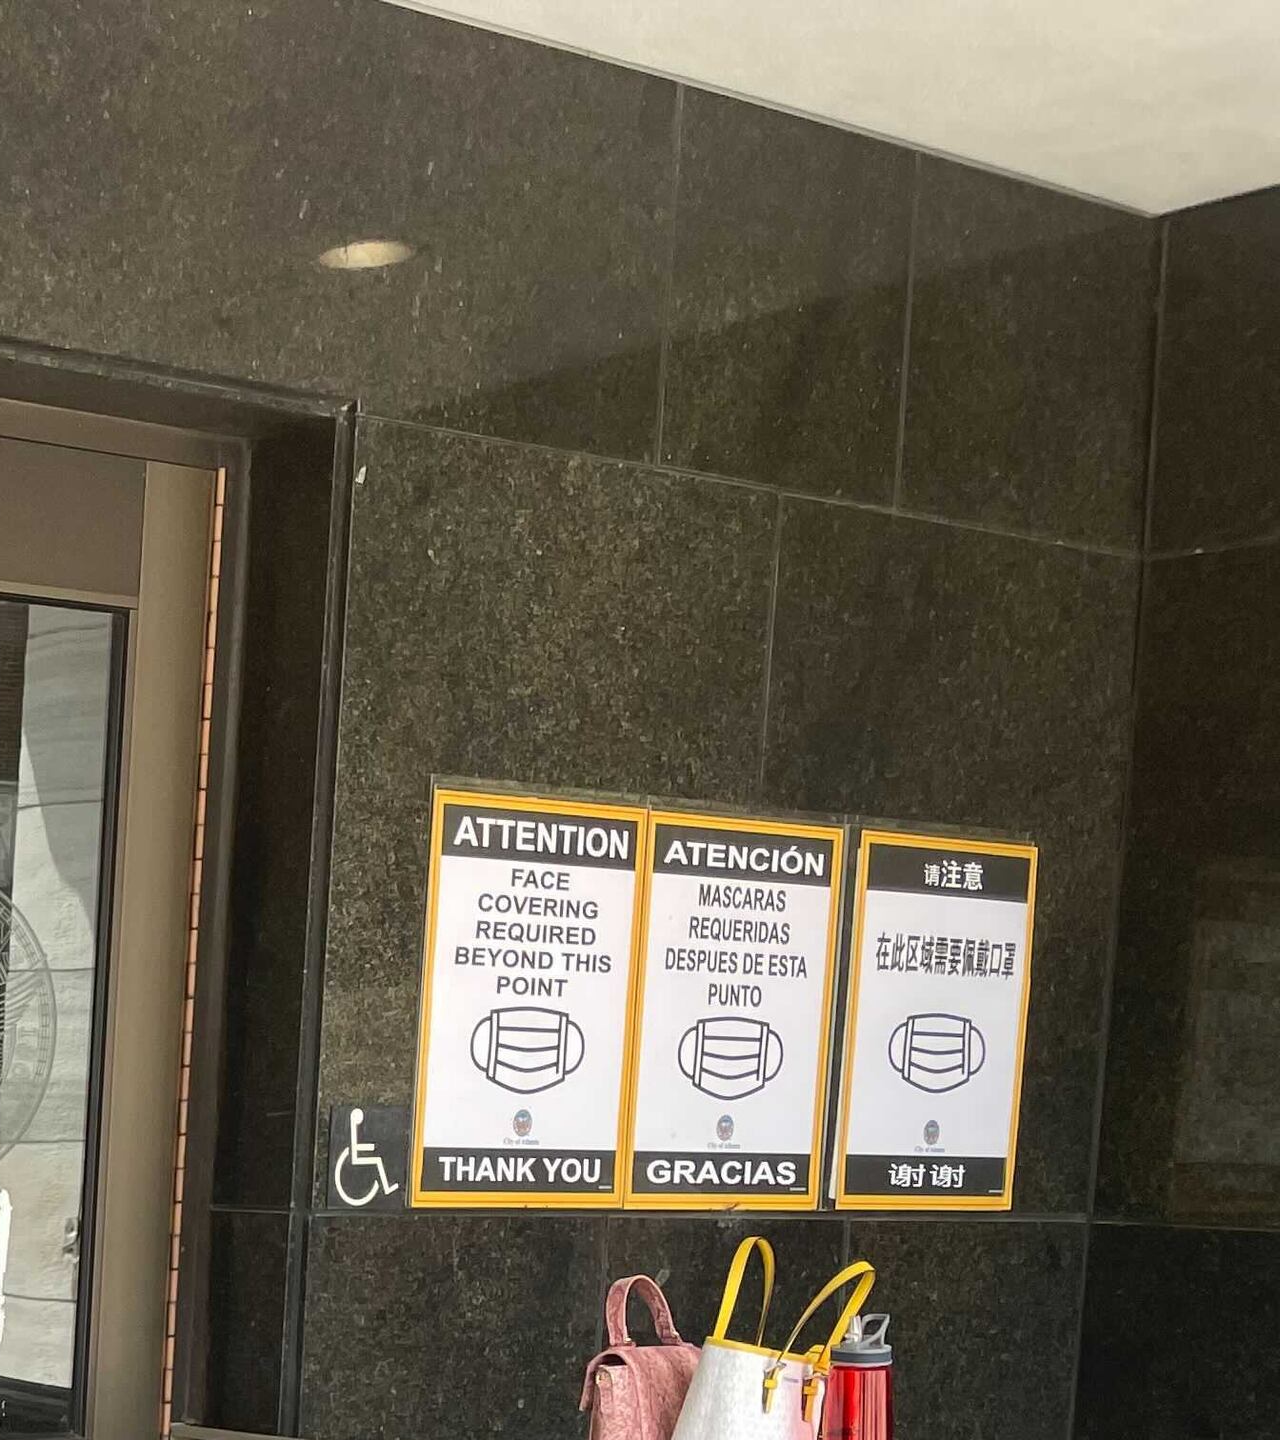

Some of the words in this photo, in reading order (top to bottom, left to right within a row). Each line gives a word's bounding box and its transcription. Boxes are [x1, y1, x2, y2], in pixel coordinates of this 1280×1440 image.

[453, 816, 629, 860] ATTENTION
[664, 841, 824, 876] ATENCIÓN
[511, 868, 570, 891] FACE
[924, 859, 983, 891] 请注意
[478, 893, 598, 919] COVERING
[698, 884, 787, 912] MASCARAS
[476, 920, 596, 945] REQUIRED
[689, 916, 790, 945] REQUERIDAS
[455, 946, 553, 969] BEYOND
[561, 953, 611, 973] THIS
[665, 948, 738, 974] DESPUES
[743, 953, 764, 975] DE
[768, 954, 807, 979] ESTA
[876, 930, 1016, 979] 在此区域需要佩戴口罩
[497, 976, 568, 997] POINT
[708, 984, 762, 1008] PUNTO
[438, 1156, 536, 1183] THANK
[542, 1157, 601, 1184] YOU
[646, 1160, 797, 1187] GRACIAS
